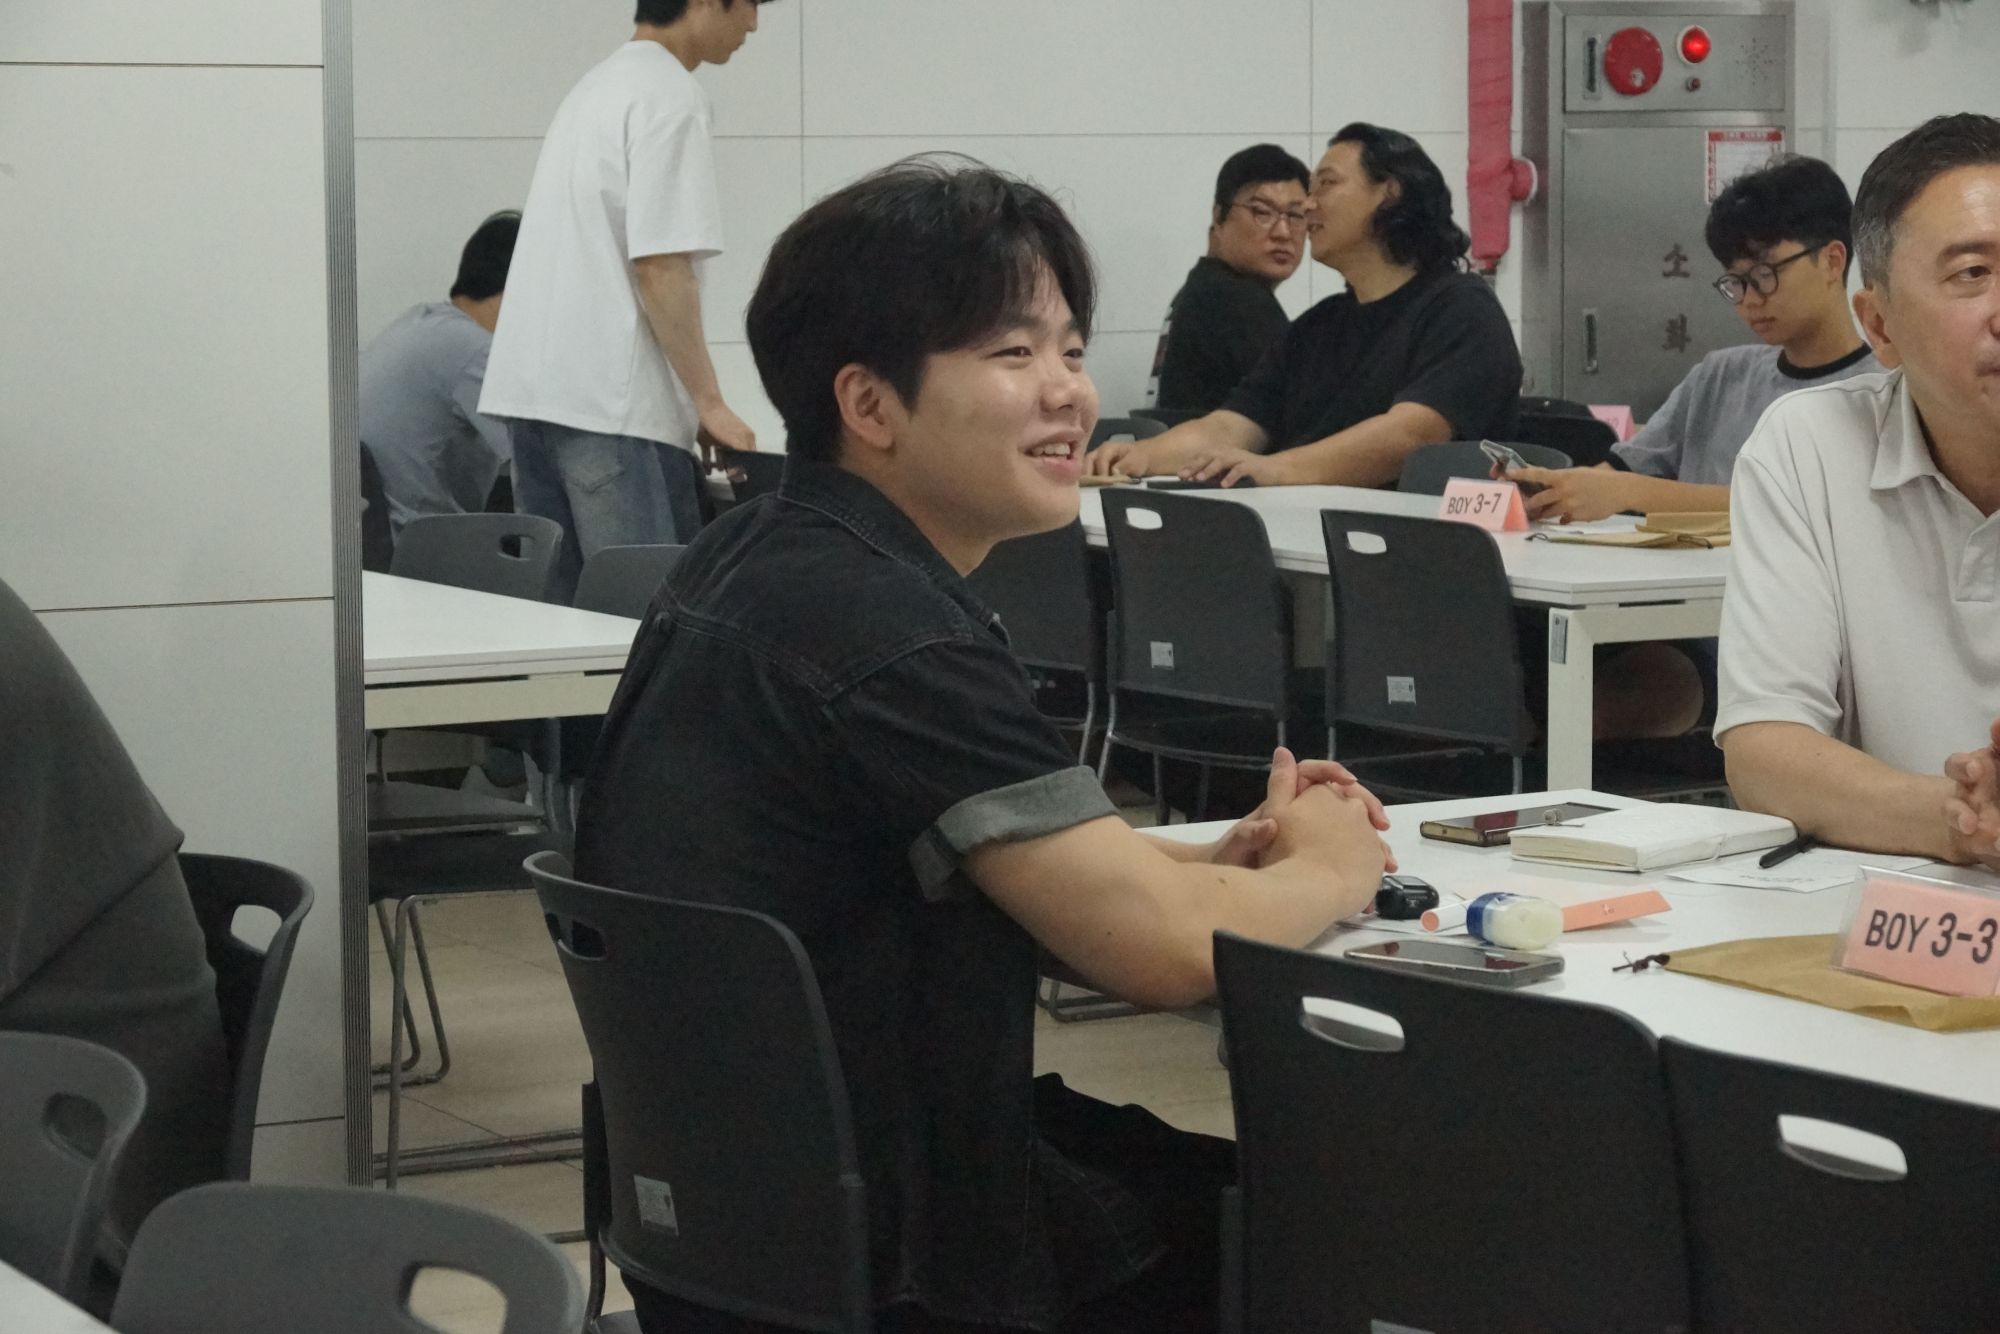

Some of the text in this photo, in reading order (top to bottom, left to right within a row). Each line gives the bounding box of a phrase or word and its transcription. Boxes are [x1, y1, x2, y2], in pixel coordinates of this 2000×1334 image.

[1447, 492, 1502, 514] BOY 3-7
[1865, 909, 1998, 964] BOY 3-3
